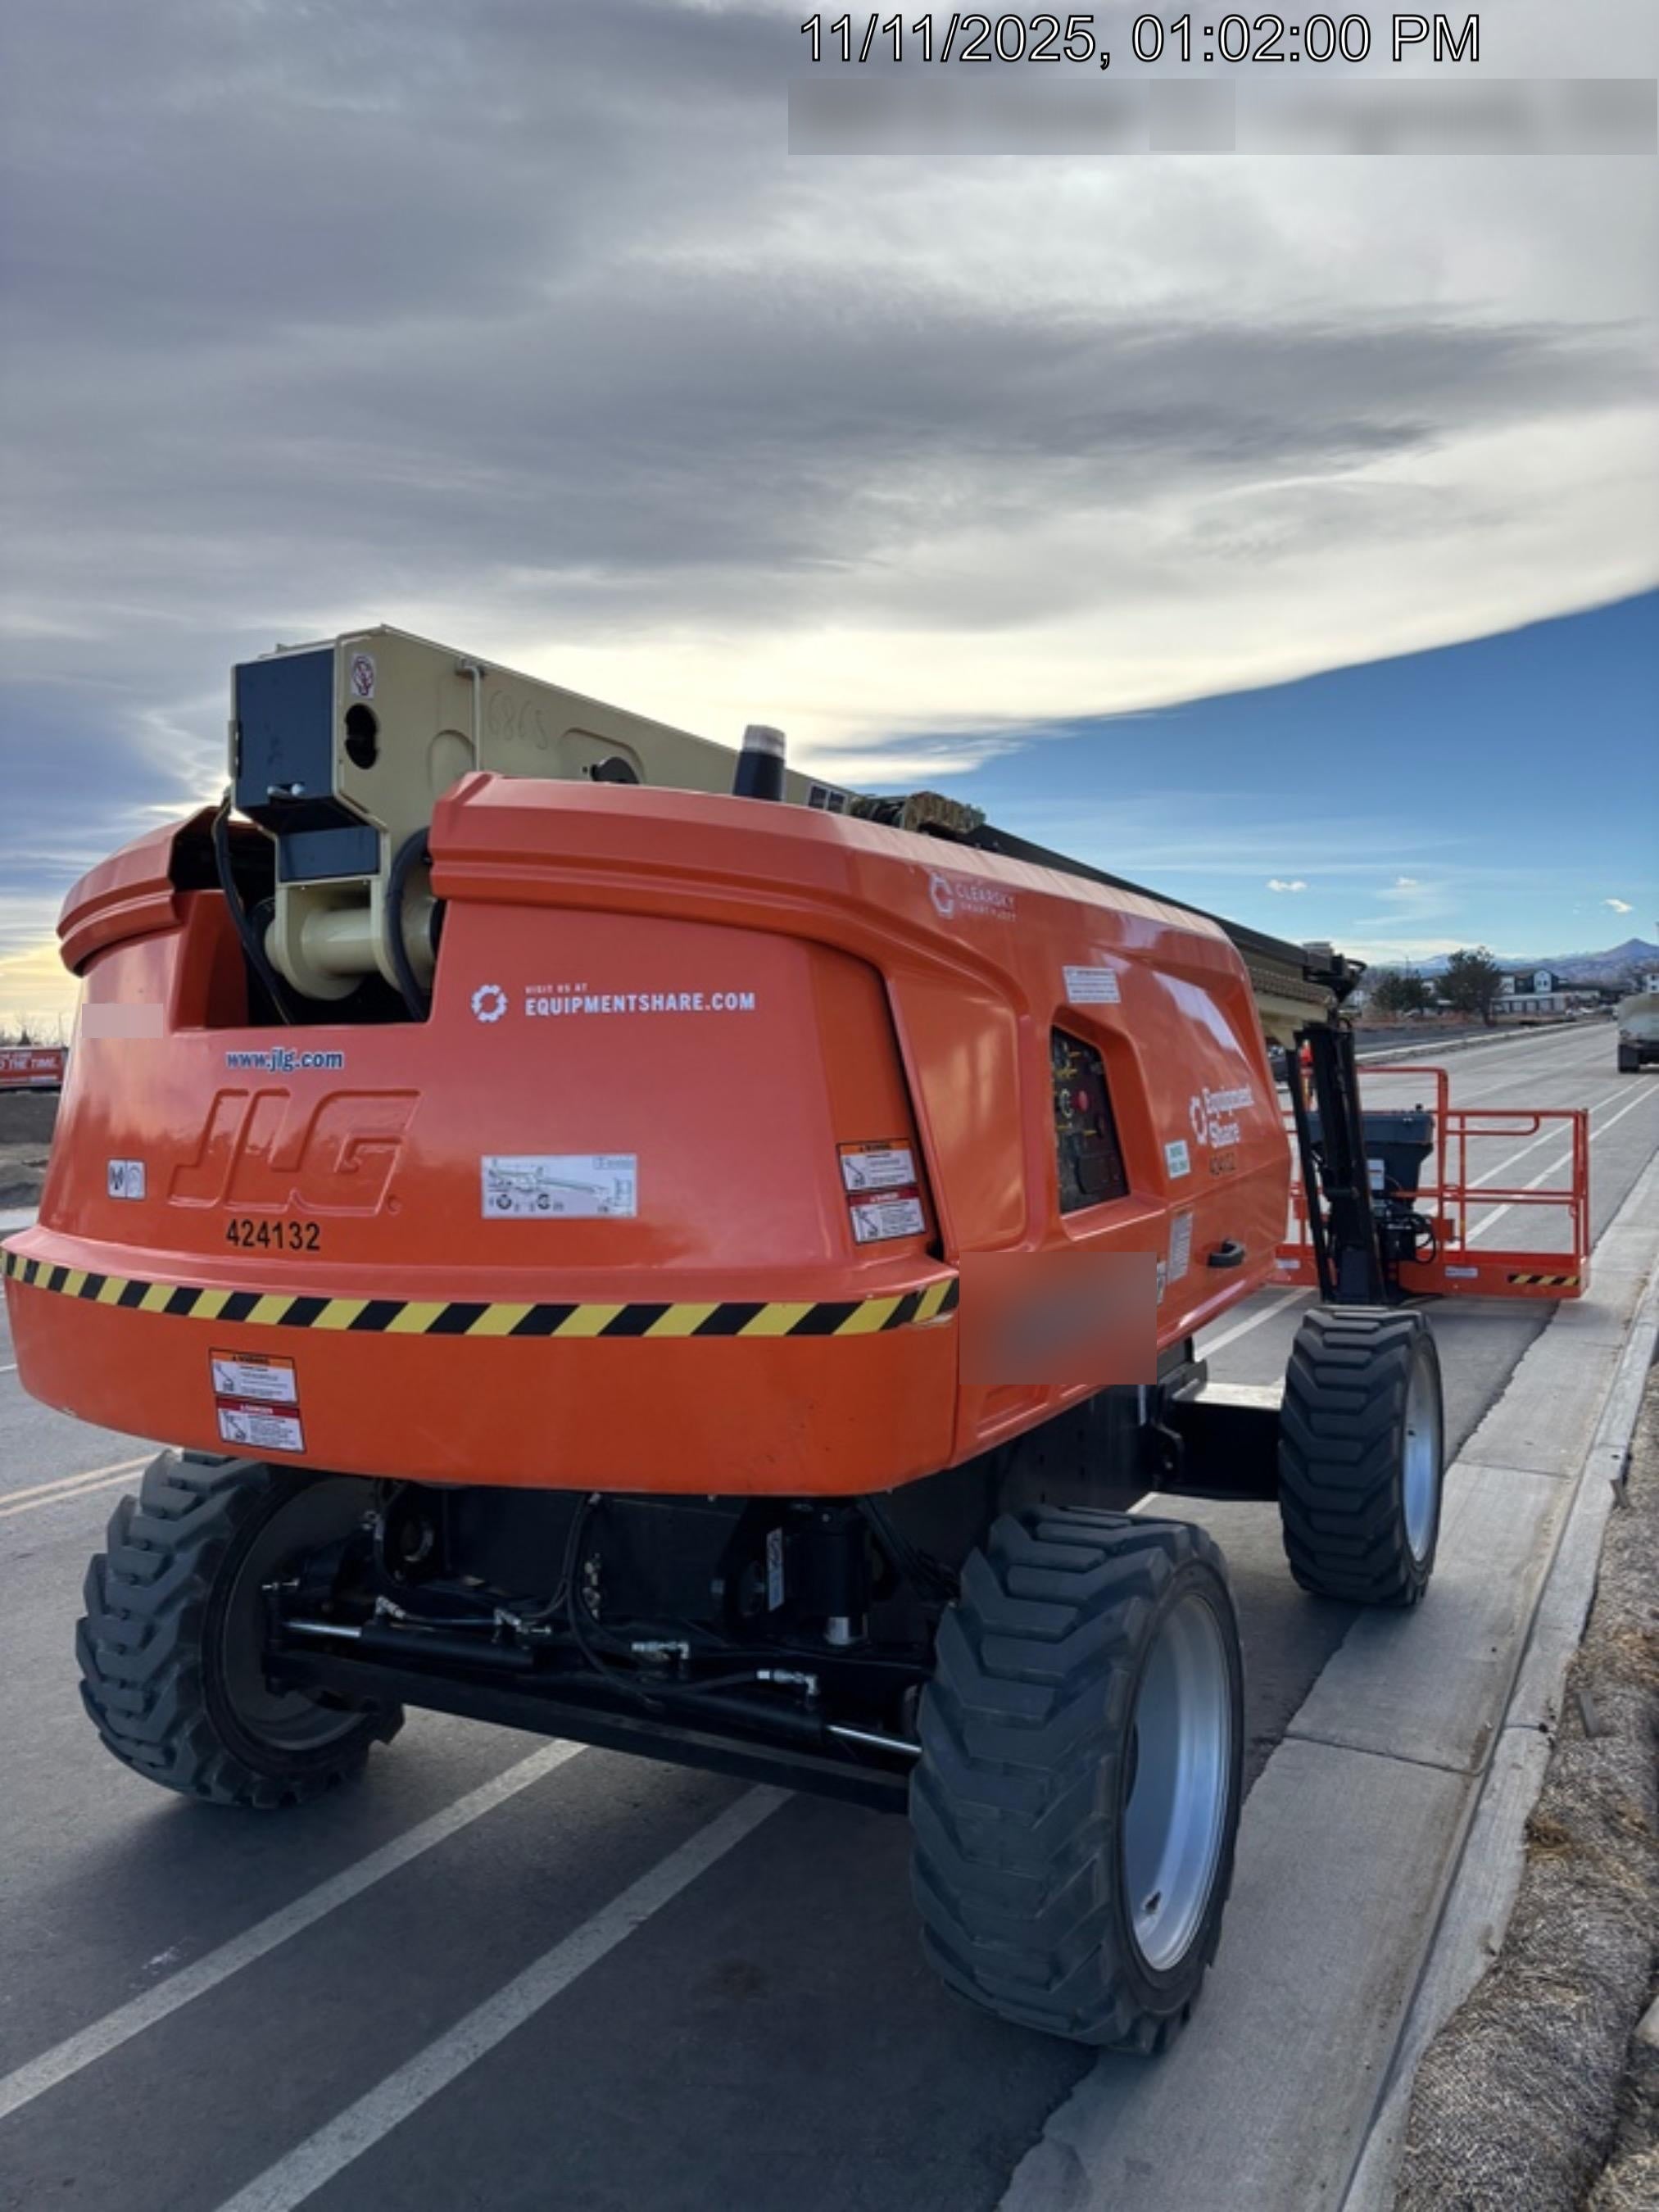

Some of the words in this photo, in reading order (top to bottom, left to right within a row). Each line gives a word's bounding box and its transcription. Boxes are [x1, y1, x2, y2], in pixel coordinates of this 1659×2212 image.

[524, 992, 756, 1017] EQUIPMENTSHARE.COM
[226, 1048, 344, 1072] www.jlg.com
[165, 1089, 420, 1217] JLG
[225, 1218, 321, 1251] 424132
